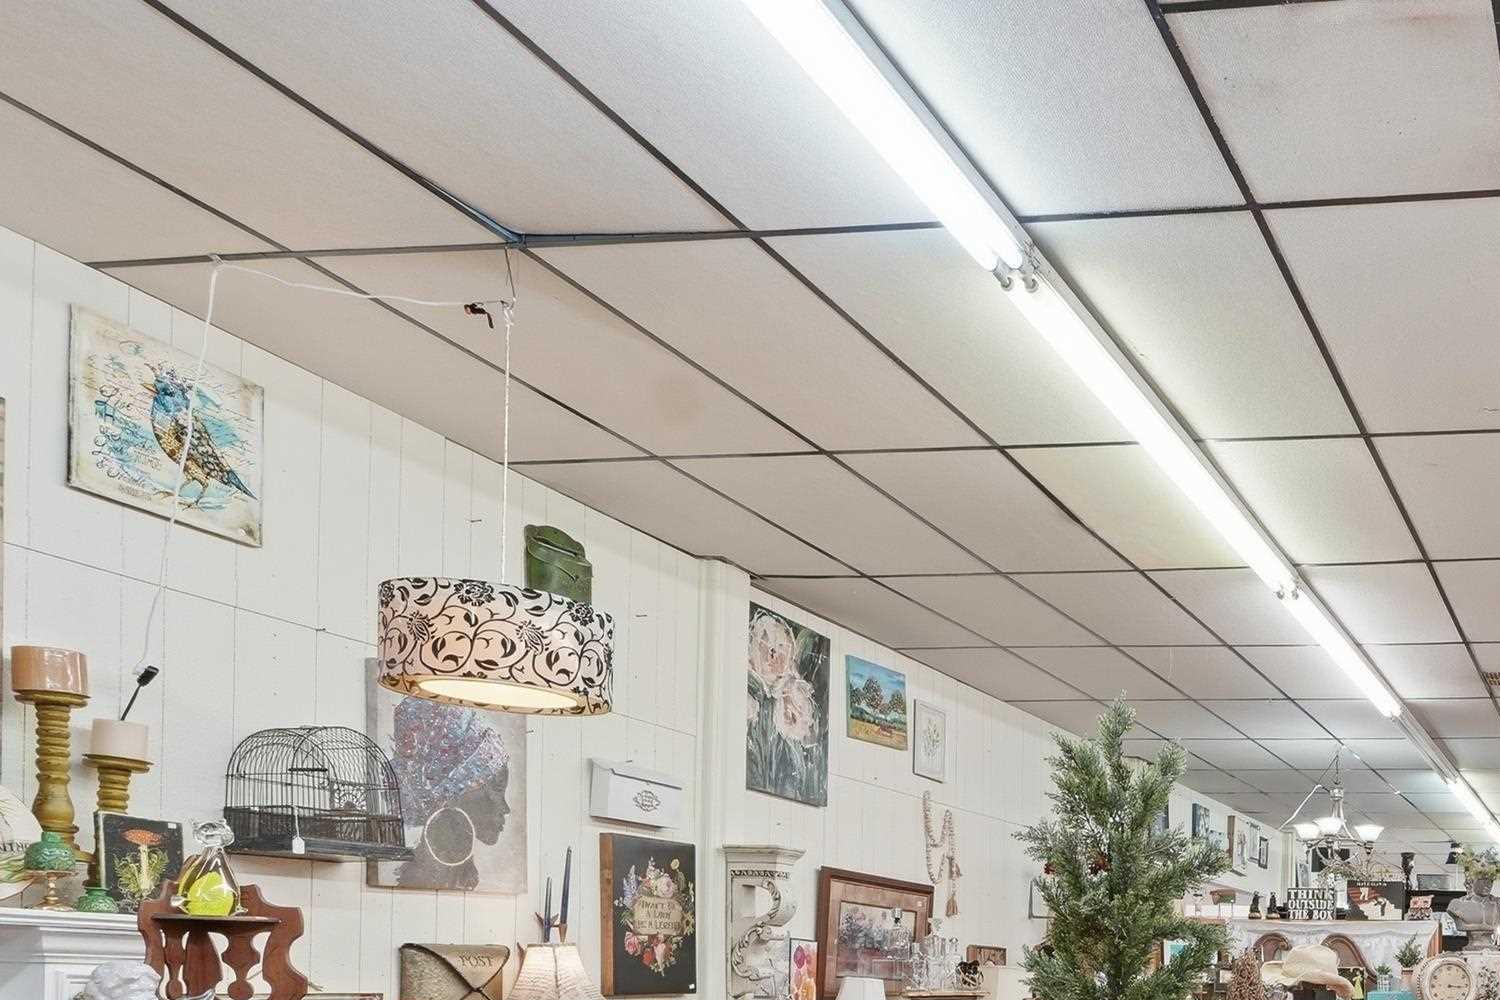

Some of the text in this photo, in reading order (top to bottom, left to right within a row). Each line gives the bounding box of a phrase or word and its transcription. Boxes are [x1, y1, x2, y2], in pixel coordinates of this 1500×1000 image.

[1287, 888, 1335, 900] THINK
[1288, 899, 1335, 910] OUTSIDE
[1288, 909, 1334, 920] THE BOX
[458, 954, 494, 968] POST
